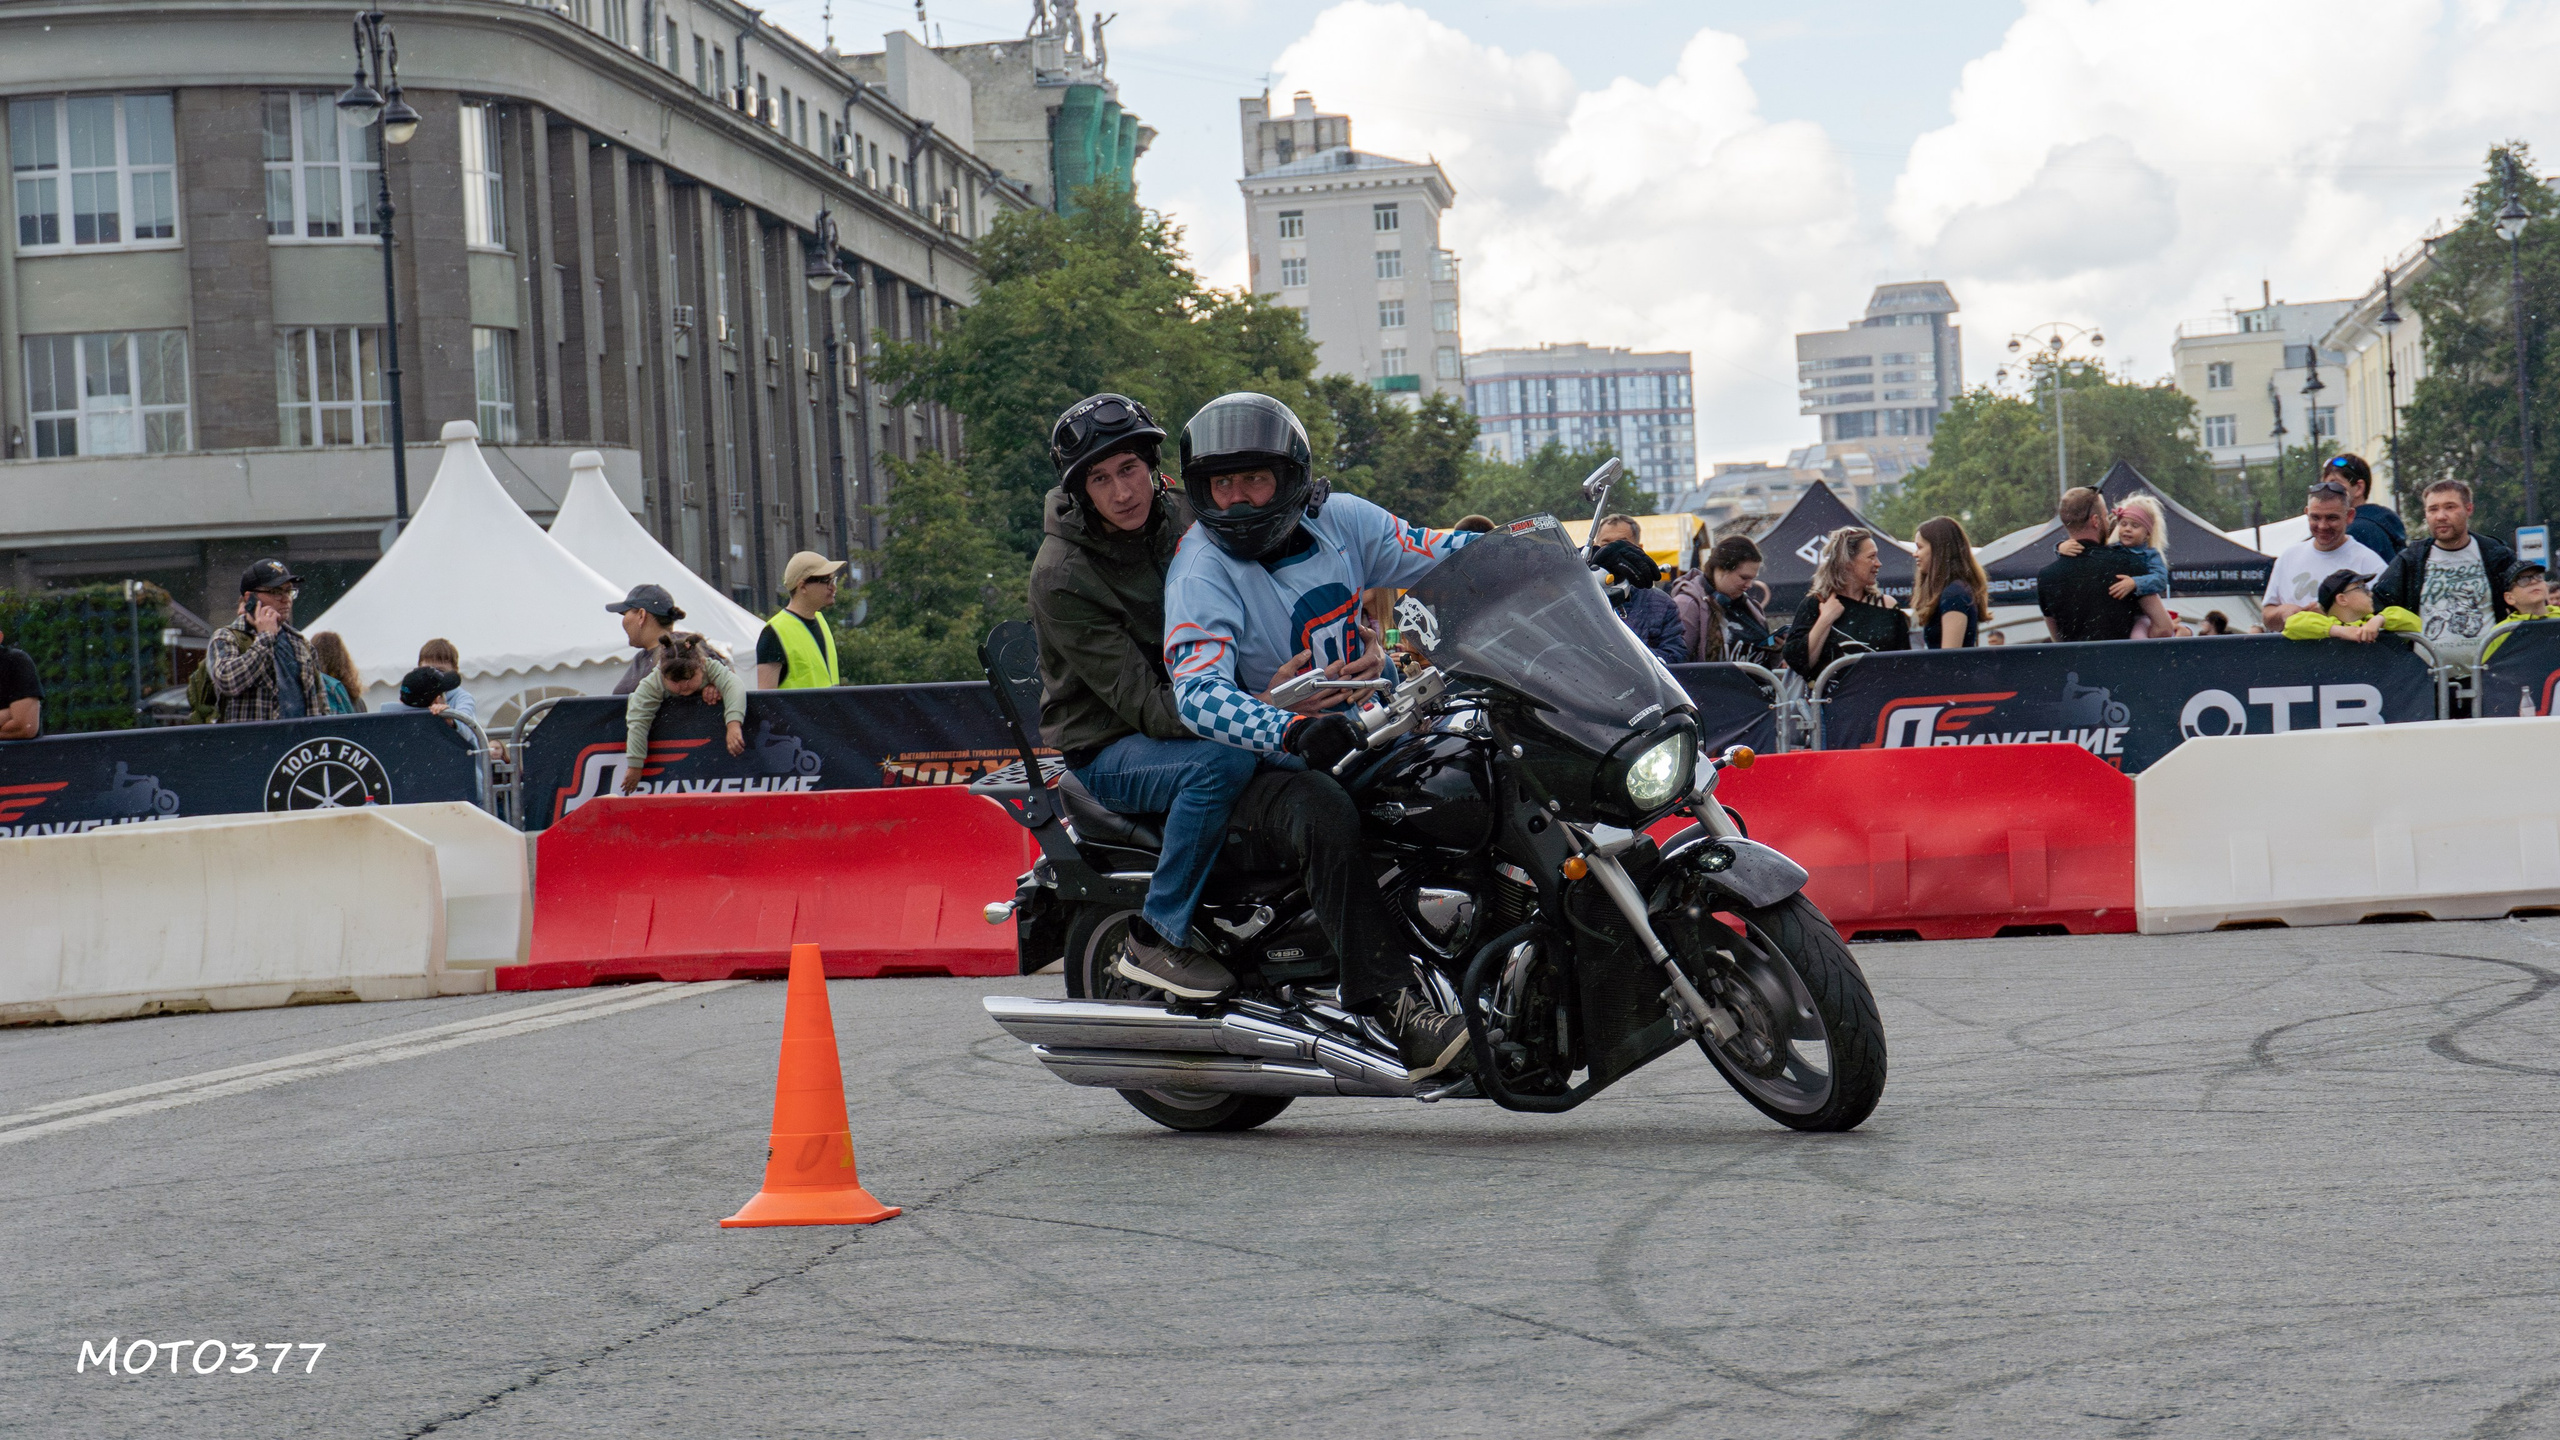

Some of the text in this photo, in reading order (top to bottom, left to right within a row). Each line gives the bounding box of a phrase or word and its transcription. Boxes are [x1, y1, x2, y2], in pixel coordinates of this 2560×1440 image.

[2171, 570, 2218, 580] UNLEASH
[2220, 570, 2239, 580] THE
[2179, 683, 2386, 742] ОТВ
[280, 743, 370, 778] 100.4 FM
